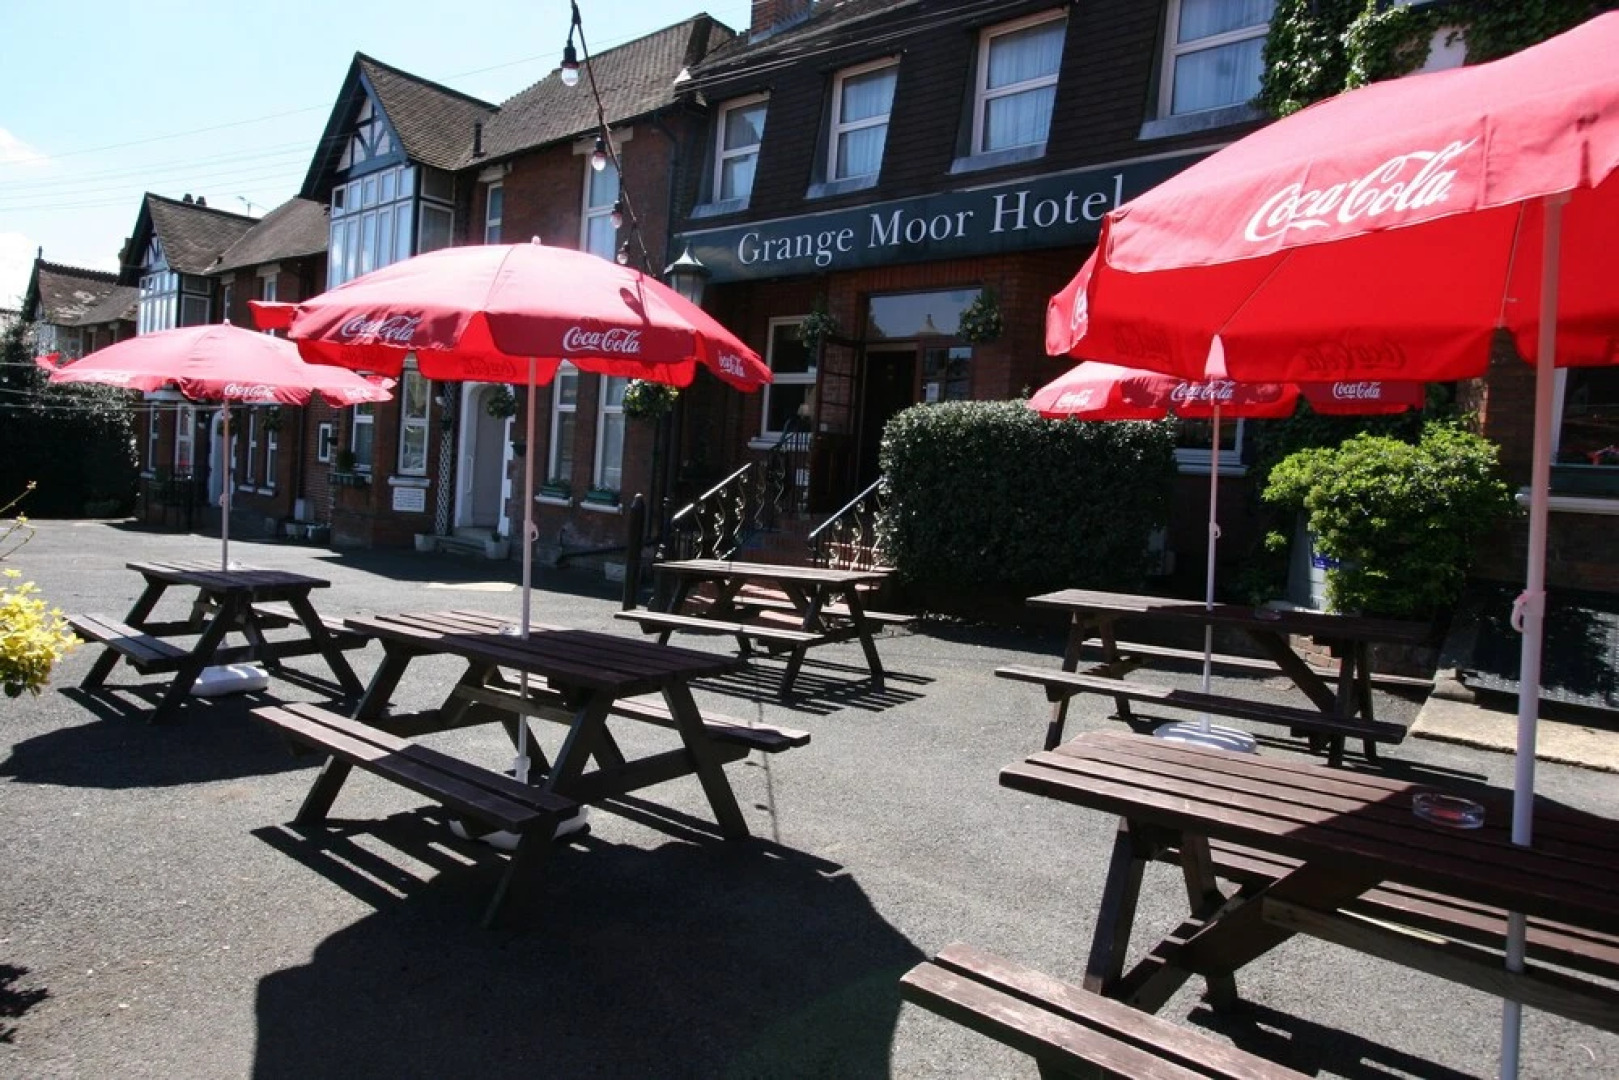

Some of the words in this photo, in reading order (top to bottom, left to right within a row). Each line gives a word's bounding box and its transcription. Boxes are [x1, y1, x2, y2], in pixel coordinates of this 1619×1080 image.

[737, 231, 854, 267] Grange
[867, 209, 974, 249] Moor
[989, 173, 1123, 233] Hotel
[1244, 135, 1480, 242] Coca-Cola
[562, 326, 642, 353] Coca-Cola
